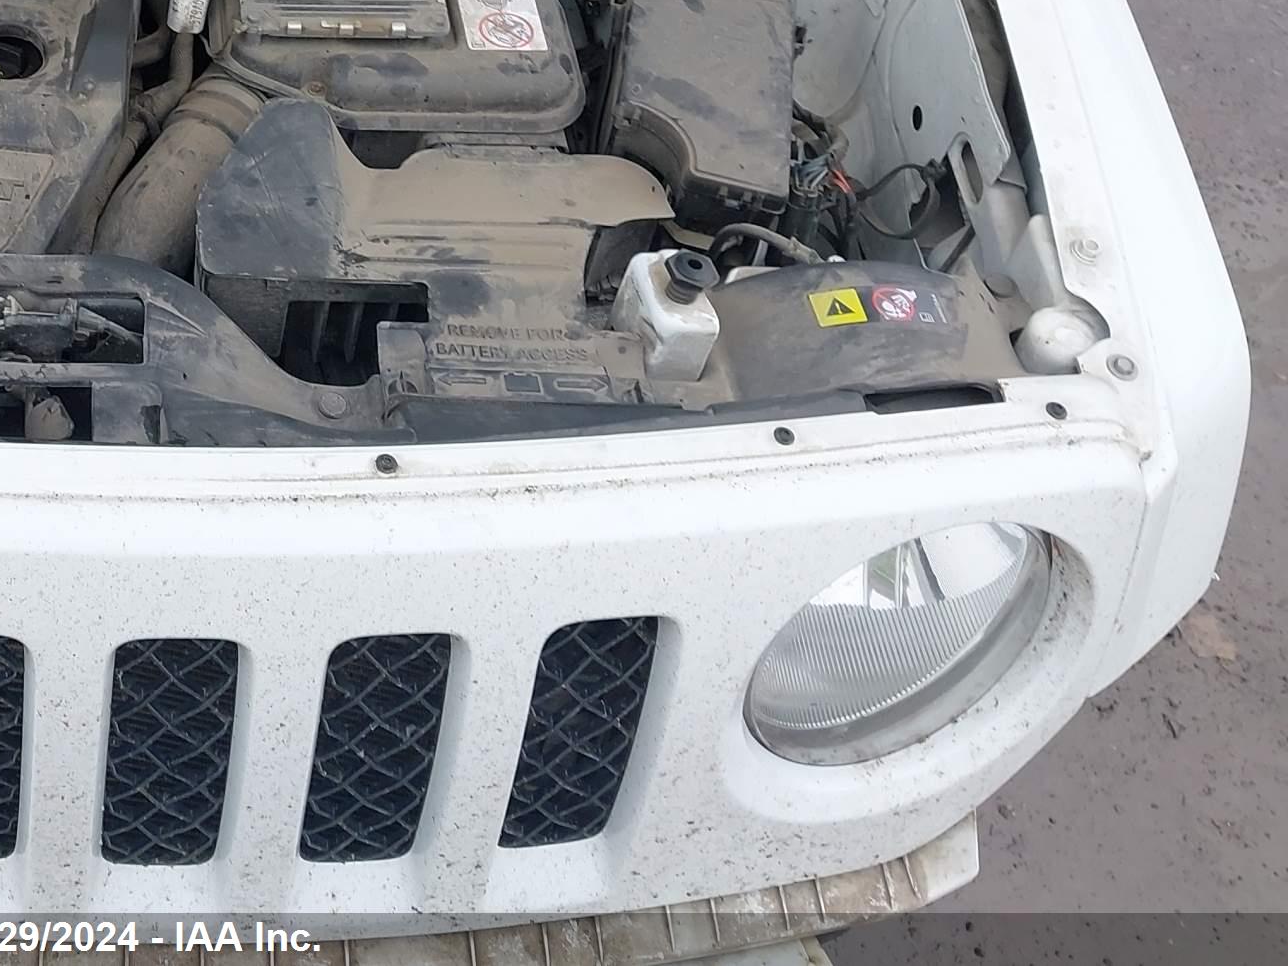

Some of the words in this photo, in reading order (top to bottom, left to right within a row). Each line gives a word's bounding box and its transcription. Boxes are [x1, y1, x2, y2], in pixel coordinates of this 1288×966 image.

[446, 323, 520, 340] REMOVE
[528, 328, 568, 342] FOR
[435, 341, 509, 360] BATTERY
[516, 347, 589, 363] ACCESS
